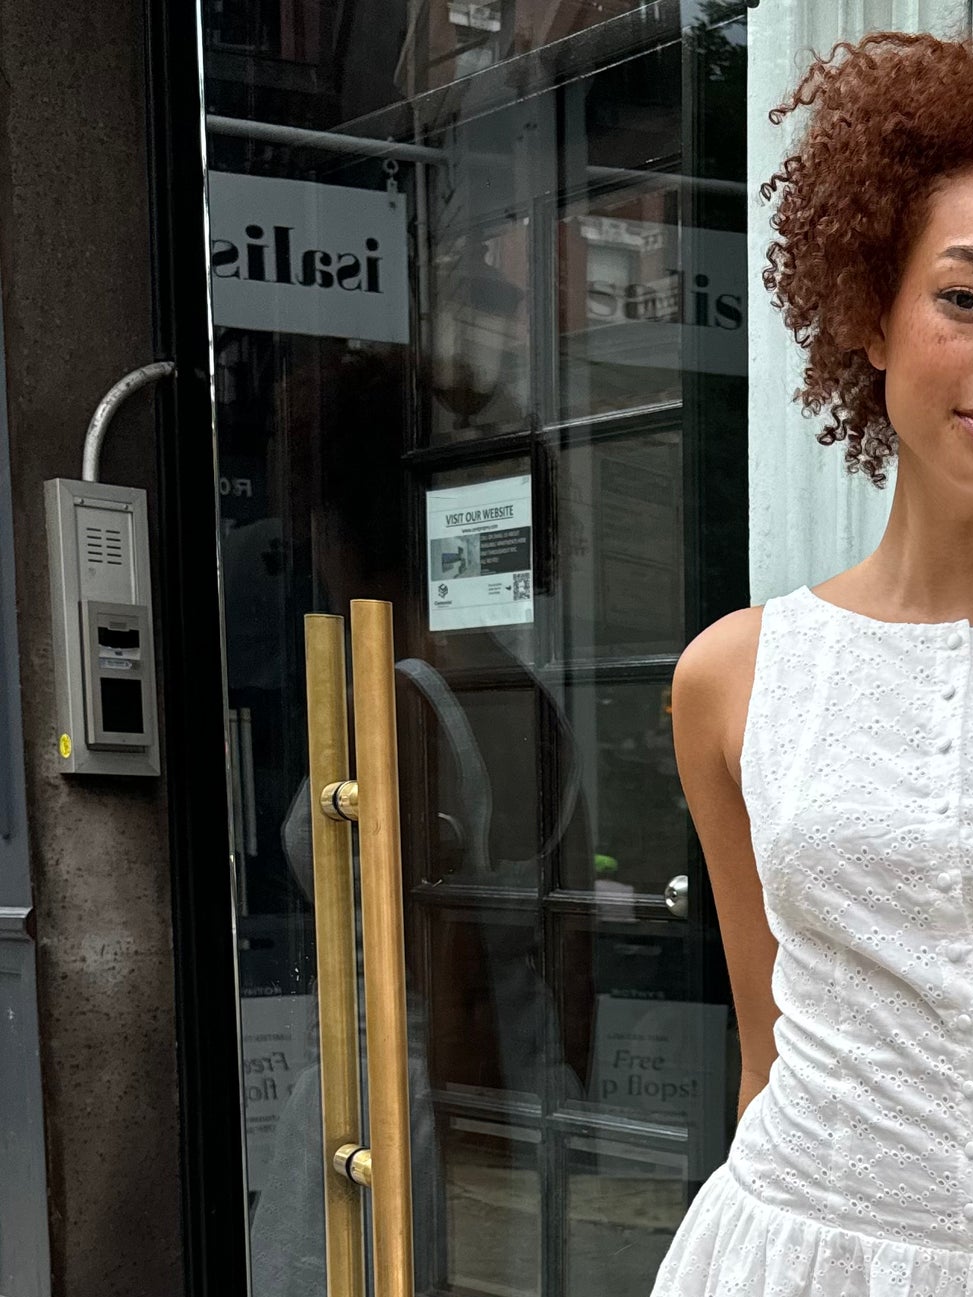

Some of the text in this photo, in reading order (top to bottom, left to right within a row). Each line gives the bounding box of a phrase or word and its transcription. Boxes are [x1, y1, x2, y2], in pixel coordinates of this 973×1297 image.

[445, 504, 514, 525] VISIT OUR WEBSITE
[613, 1049, 665, 1071] Free
[628, 1074, 698, 1102] flops!
